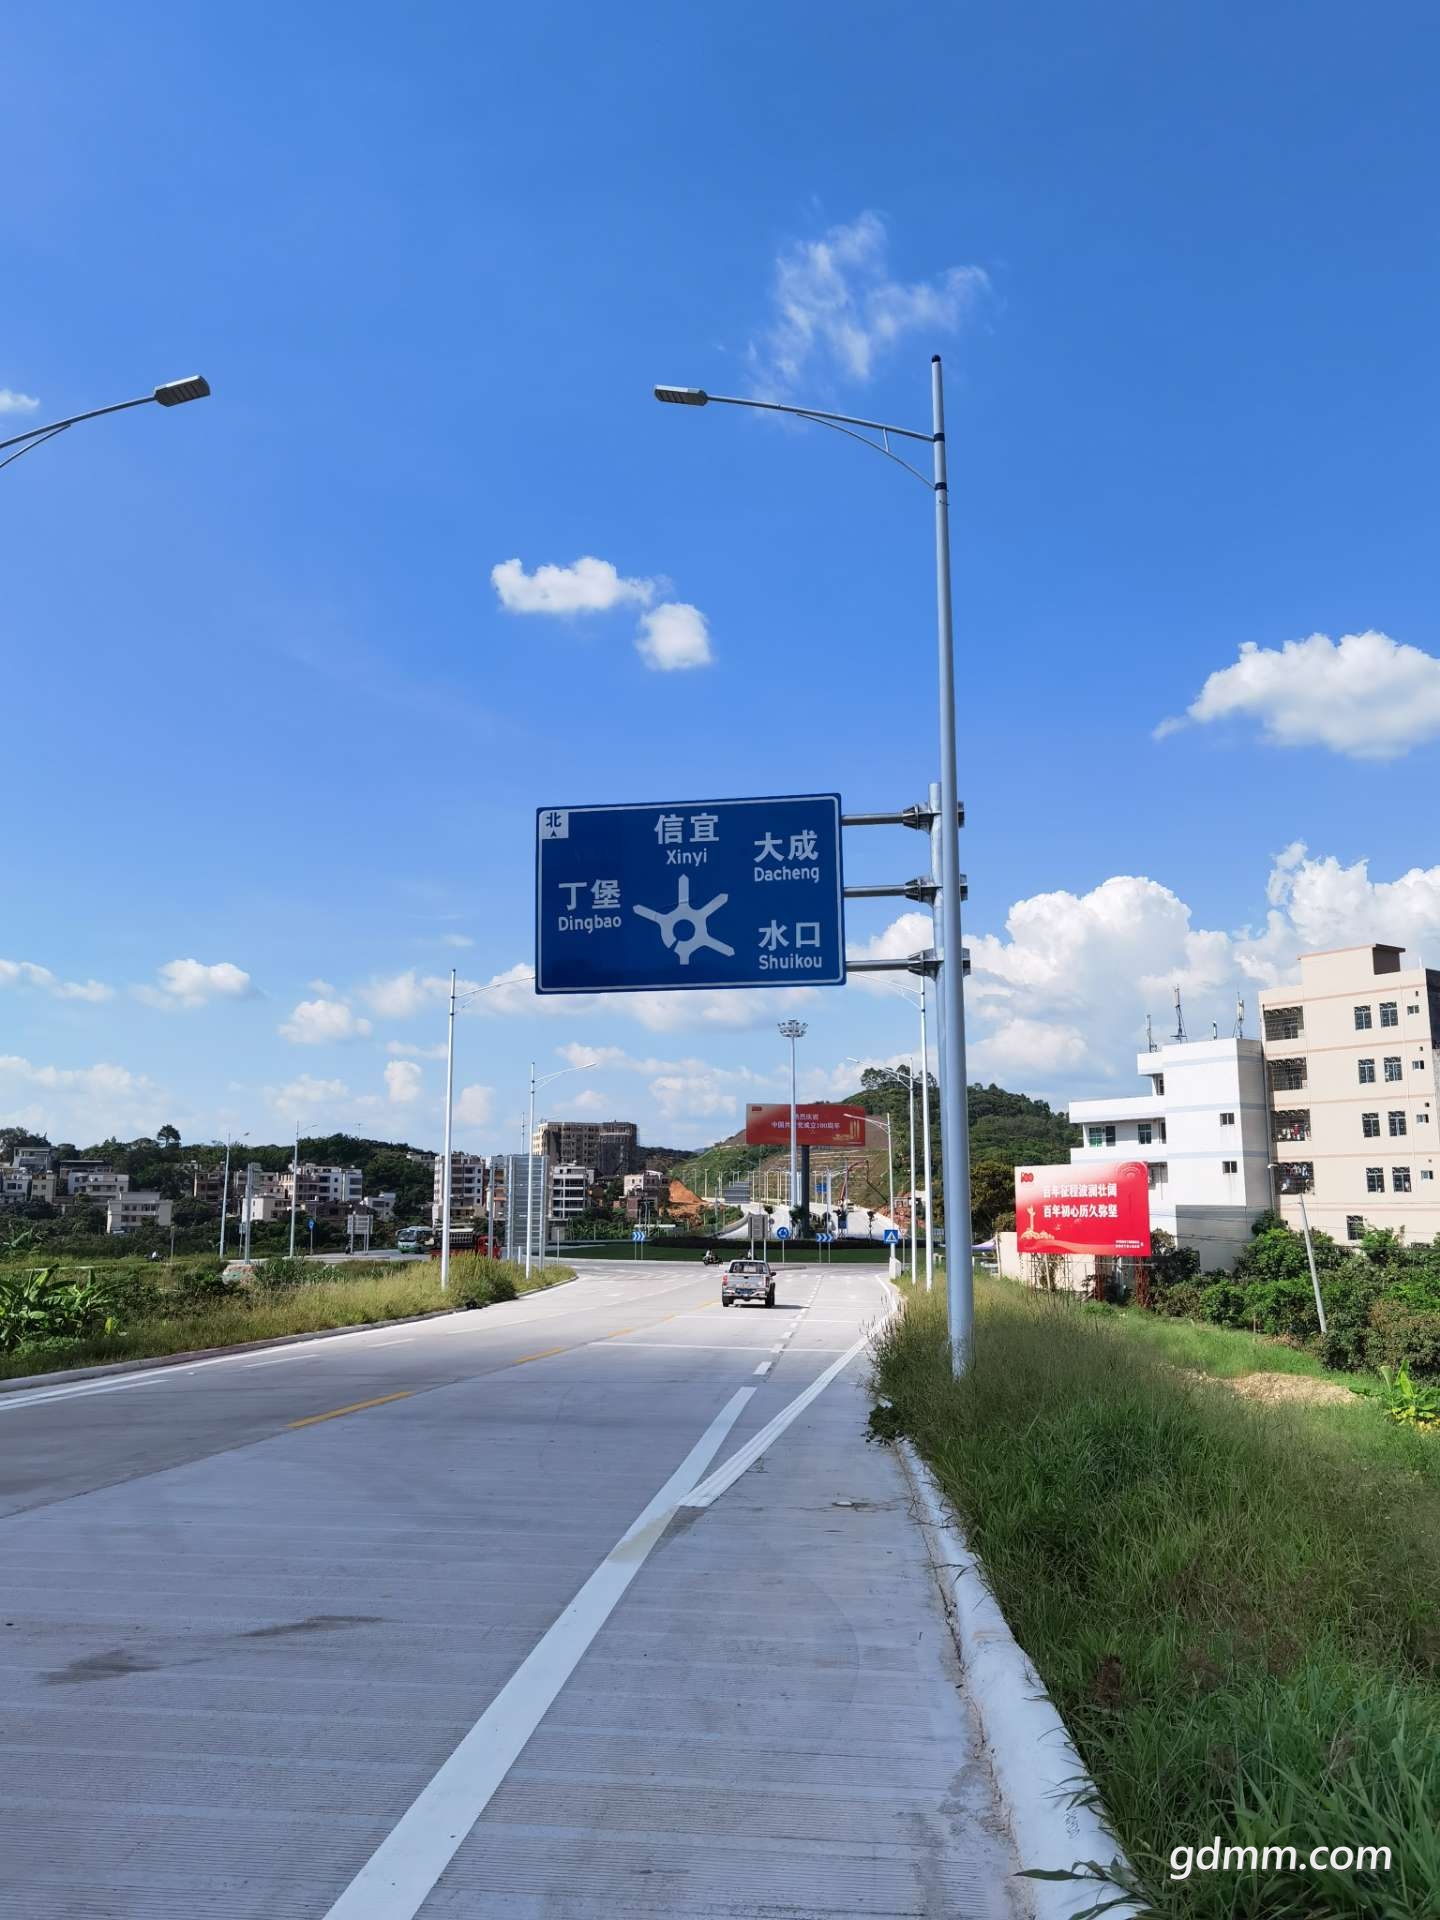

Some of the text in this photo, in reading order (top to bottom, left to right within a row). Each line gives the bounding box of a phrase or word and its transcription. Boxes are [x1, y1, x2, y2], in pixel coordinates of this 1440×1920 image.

[545, 811, 562, 828] 北
[654, 812, 720, 845] 信宜
[753, 829, 819, 863] 大成
[666, 848, 708, 866] Xinyi
[754, 866, 820, 883] Dacheng
[558, 879, 622, 911] 丁堡
[558, 915, 622, 934] Dingbao
[758, 919, 821, 951] 水口
[758, 952, 823, 970] Shuikou
[771, 1121, 841, 1129] 中国共党成立100周年
[1043, 1204, 1119, 1219] 百年初心历久弥坚
